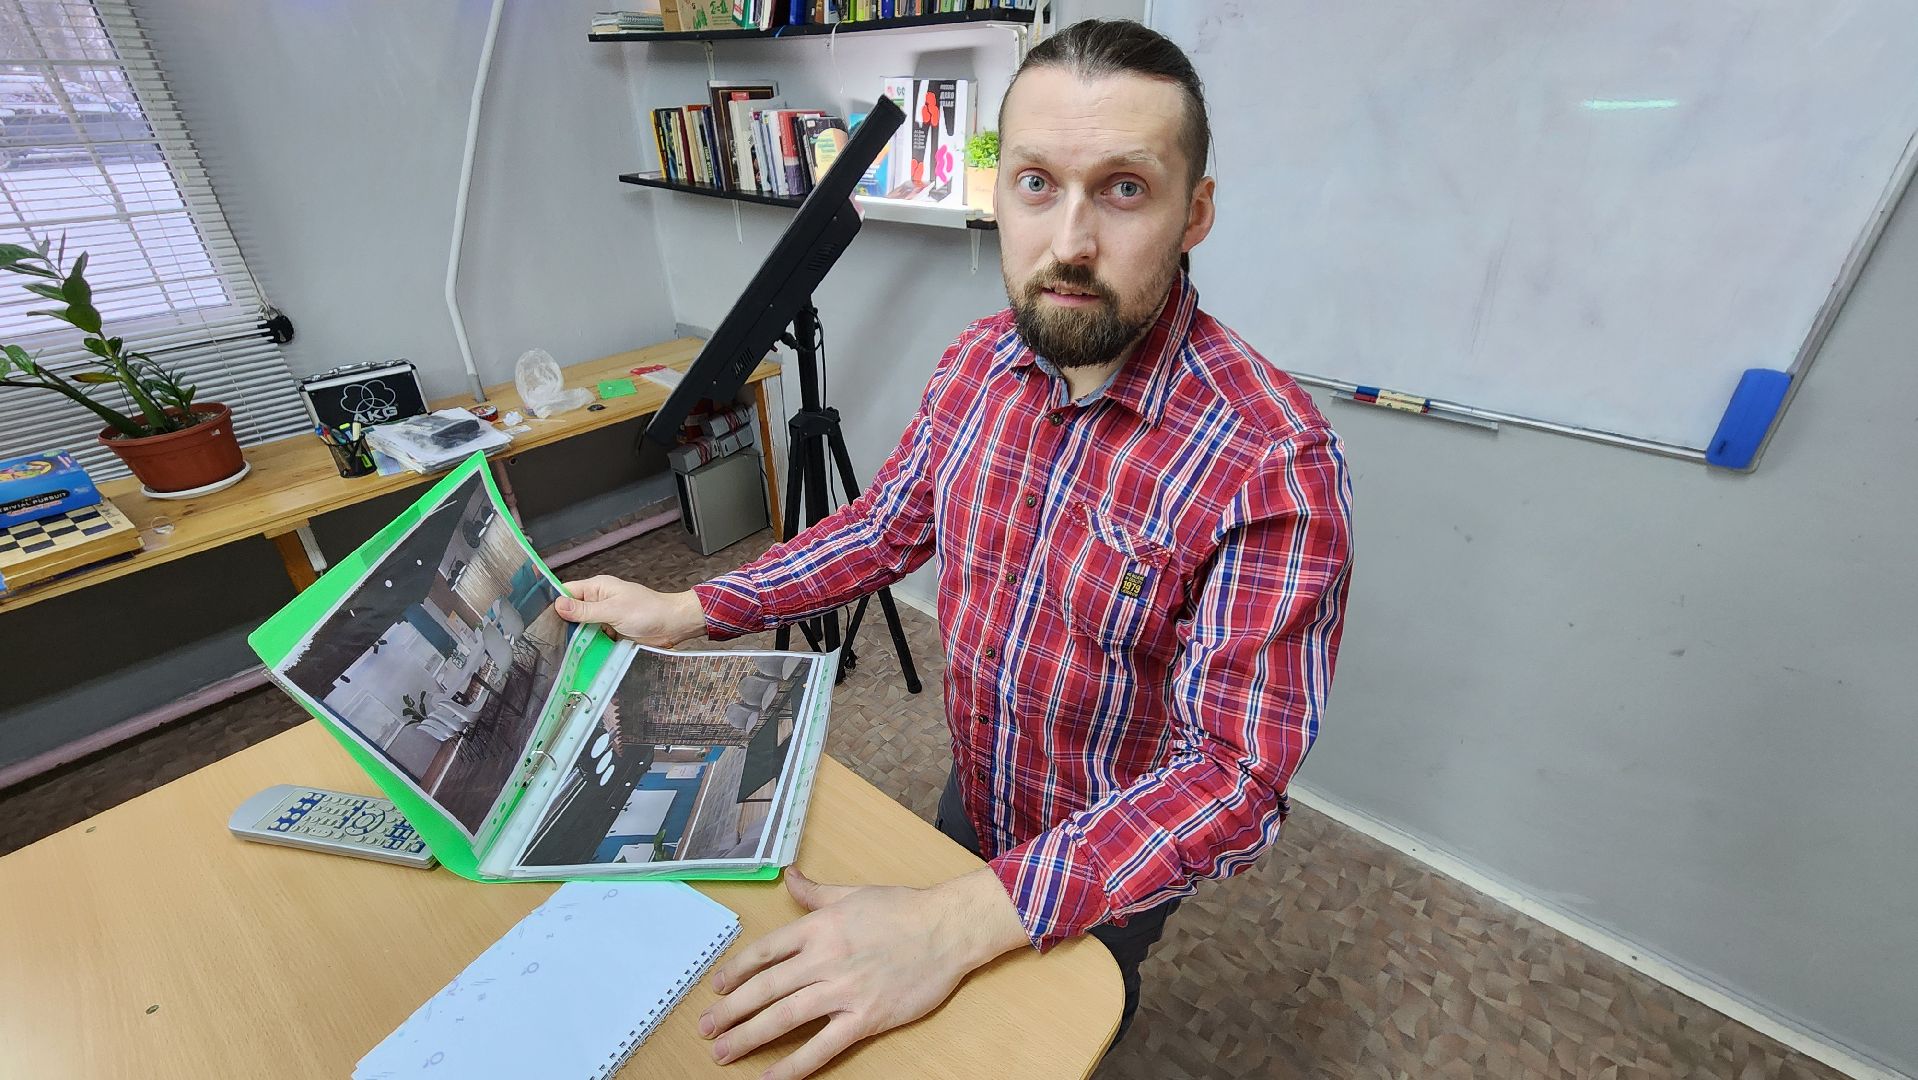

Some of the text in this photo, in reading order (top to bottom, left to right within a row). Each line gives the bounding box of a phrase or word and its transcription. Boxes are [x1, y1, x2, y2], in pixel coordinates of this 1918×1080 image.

[353, 406, 398, 424] AKG
[32, 492, 66, 505] PURSUIT
[1122, 581, 1141, 593] 1979
